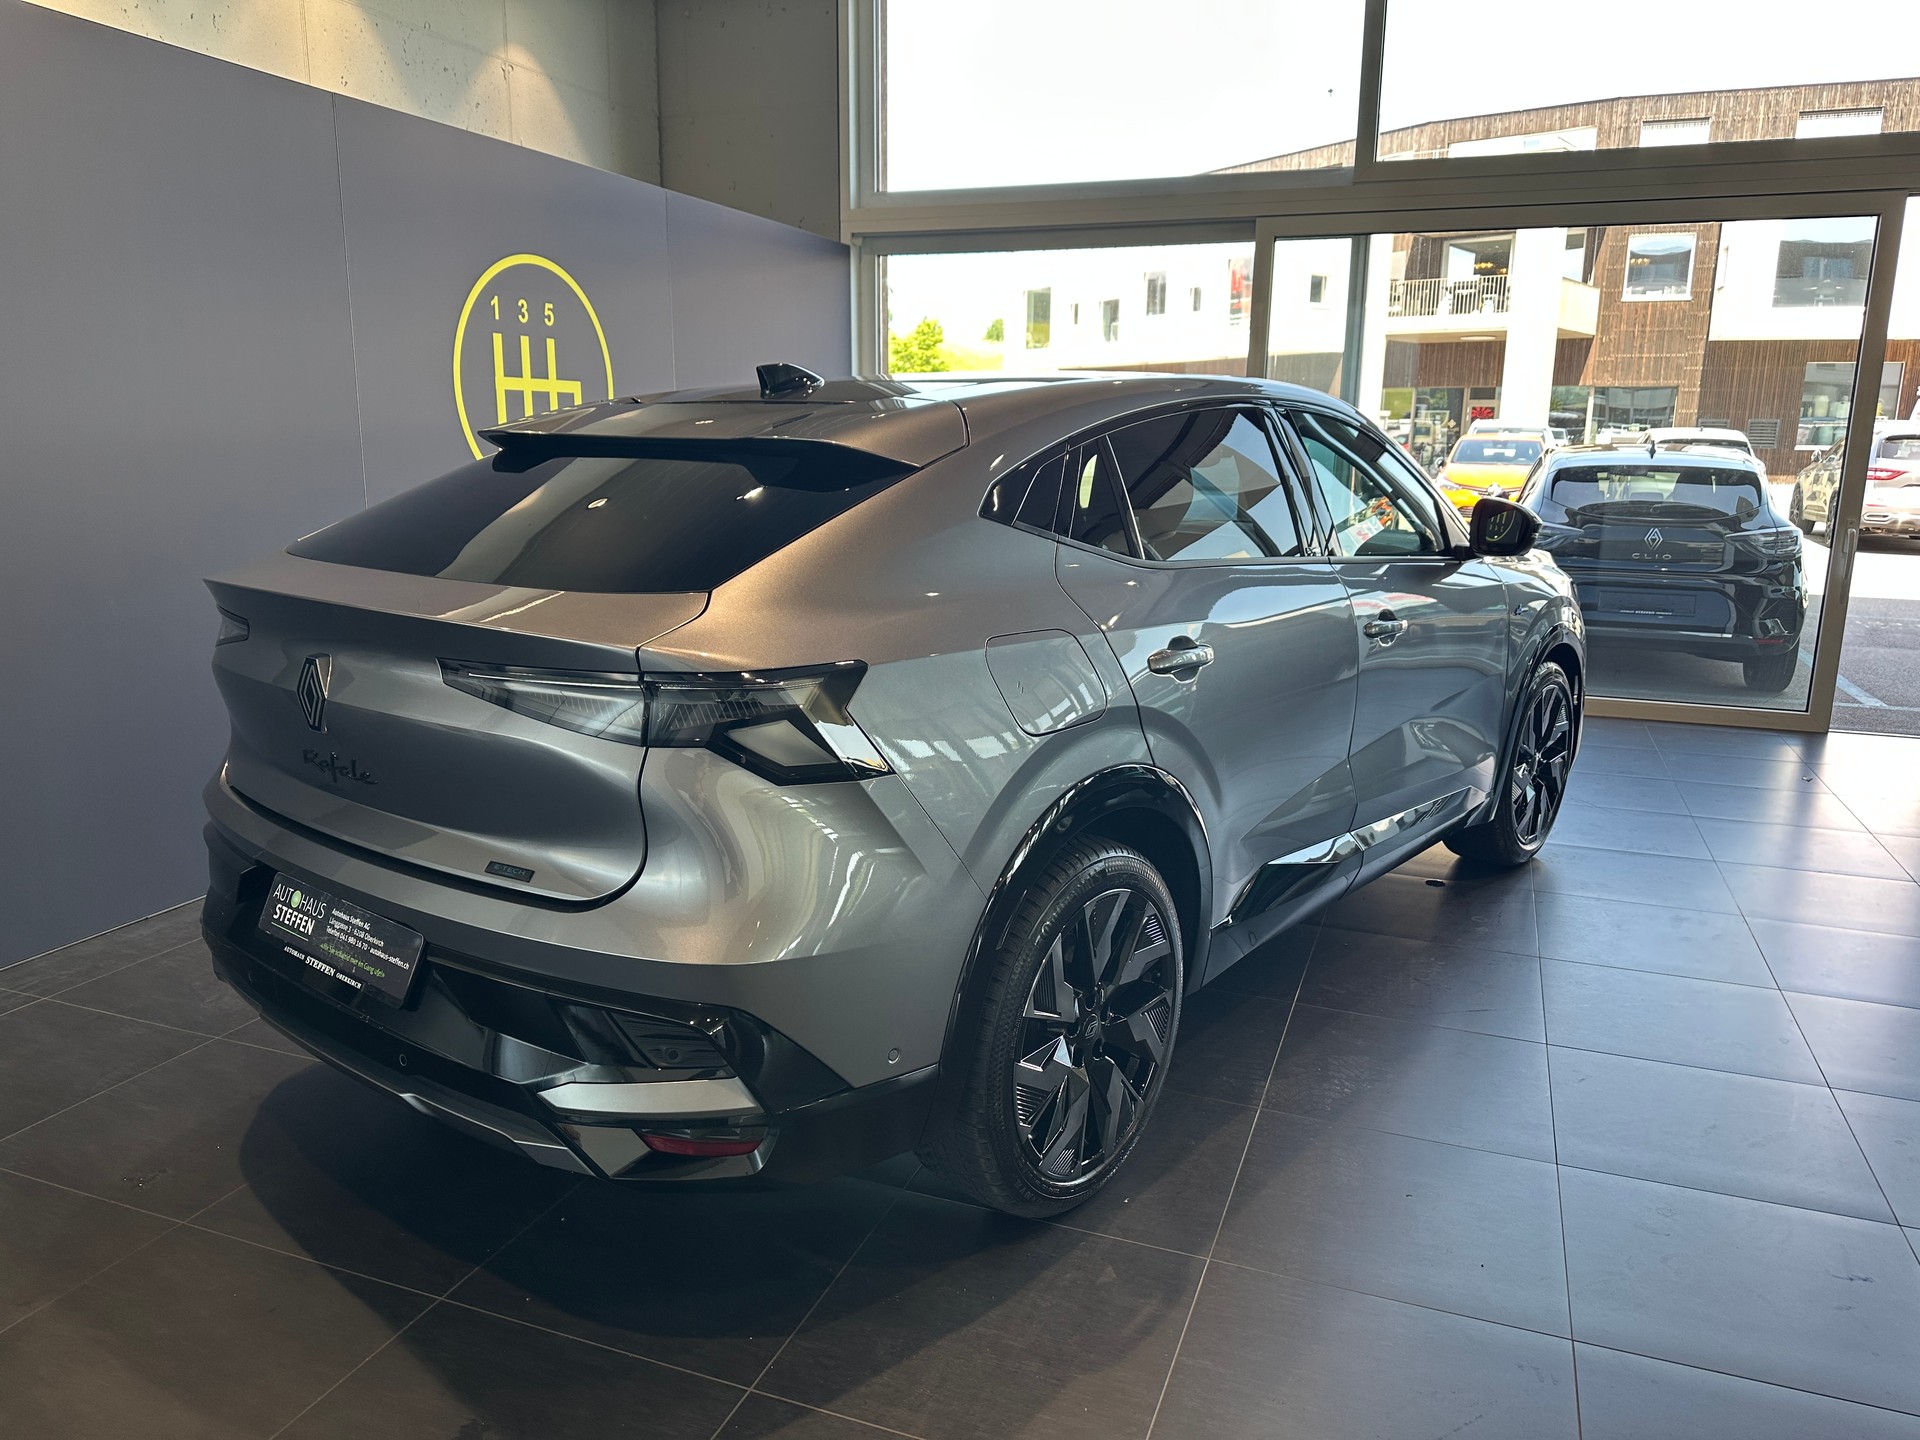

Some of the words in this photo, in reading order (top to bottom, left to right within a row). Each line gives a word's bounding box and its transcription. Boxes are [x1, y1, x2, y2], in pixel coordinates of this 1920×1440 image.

[490, 295, 500, 320] 1
[518, 298, 529, 324] 3
[544, 302, 555, 326] 5
[1632, 552, 1672, 560] CLIO
[302, 750, 378, 784] Rafale
[272, 883, 327, 919] AUTOHAUS
[273, 904, 316, 936] STEFFEN
[305, 955, 336, 977] STEFFEN
